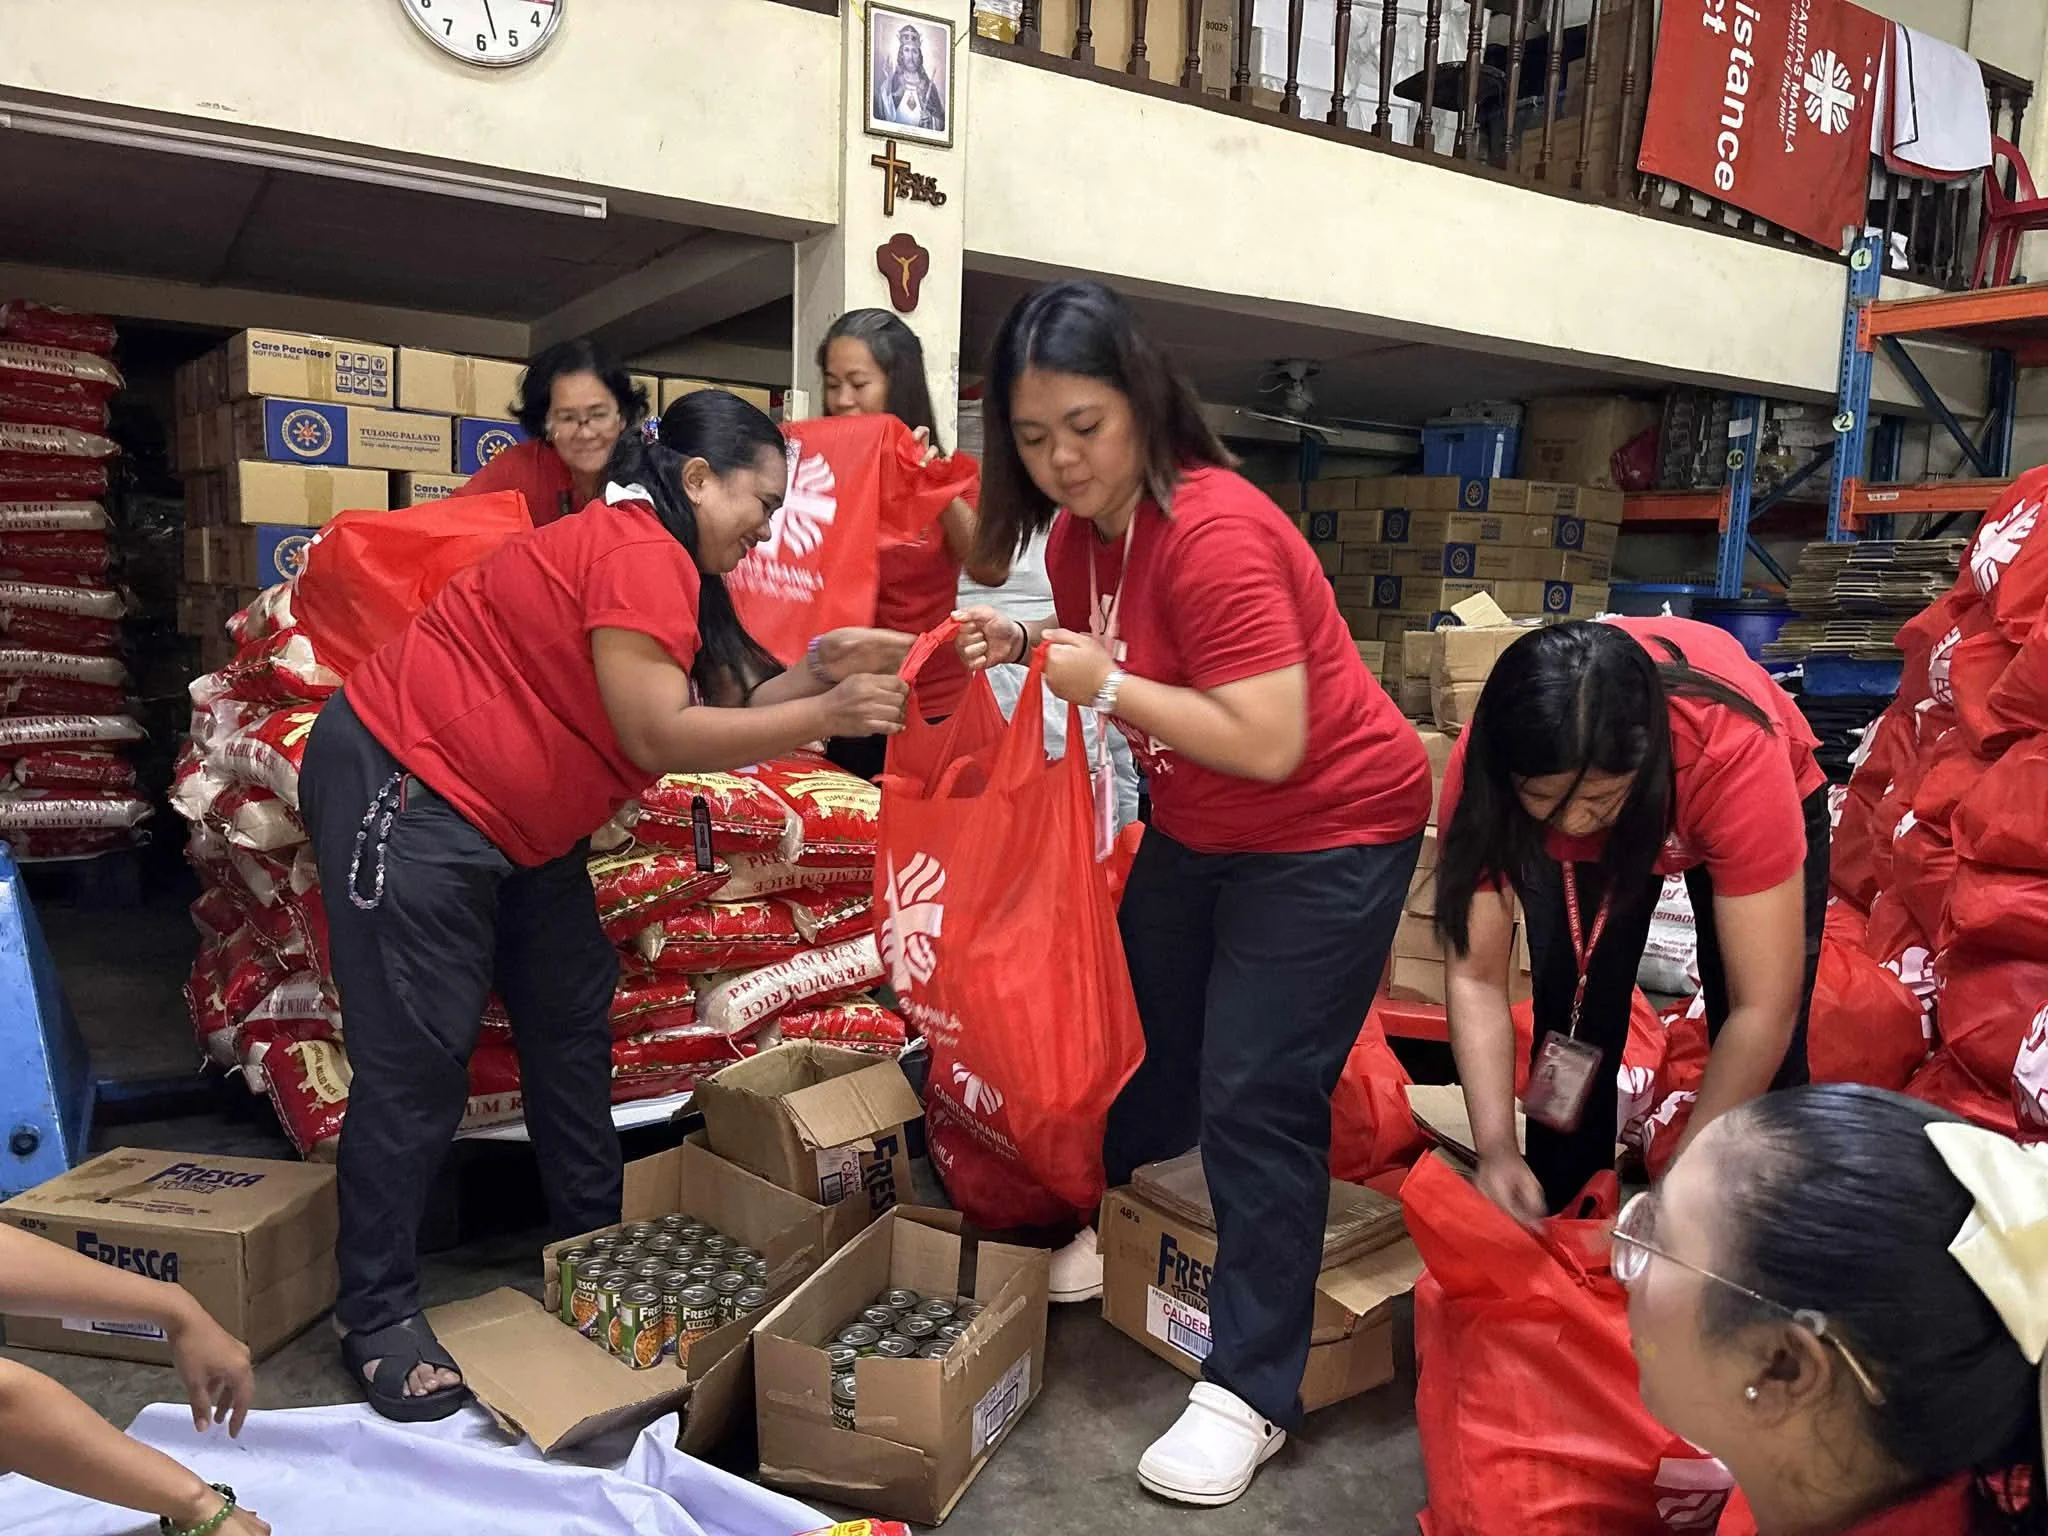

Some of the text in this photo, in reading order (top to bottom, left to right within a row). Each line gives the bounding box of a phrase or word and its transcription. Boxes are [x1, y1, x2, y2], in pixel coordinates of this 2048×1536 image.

[443, 18, 453, 35] 7
[530, 11, 541, 27] 4
[476, 34, 486, 51] 6
[508, 30, 519, 47] 5
[1778, 3, 1797, 132] church of the poor
[1785, 0, 1811, 153] CARITAS MANILA
[1858, 251, 1867, 267] 1
[252, 340, 332, 359] Care Package
[1839, 414, 1850, 428] 2
[360, 428, 441, 443] TULONG PALASYO
[1730, 453, 1744, 466] 10
[414, 484, 455, 496] Care Pa
[752, 874, 795, 894] RICE
[728, 942, 865, 1000] PREMIUM RICE
[740, 964, 867, 1021] PREMIUM RICE
[143, 1162, 266, 1188] FRESCA
[1120, 1206, 1140, 1224] 48's
[19, 1217, 48, 1231] 48's
